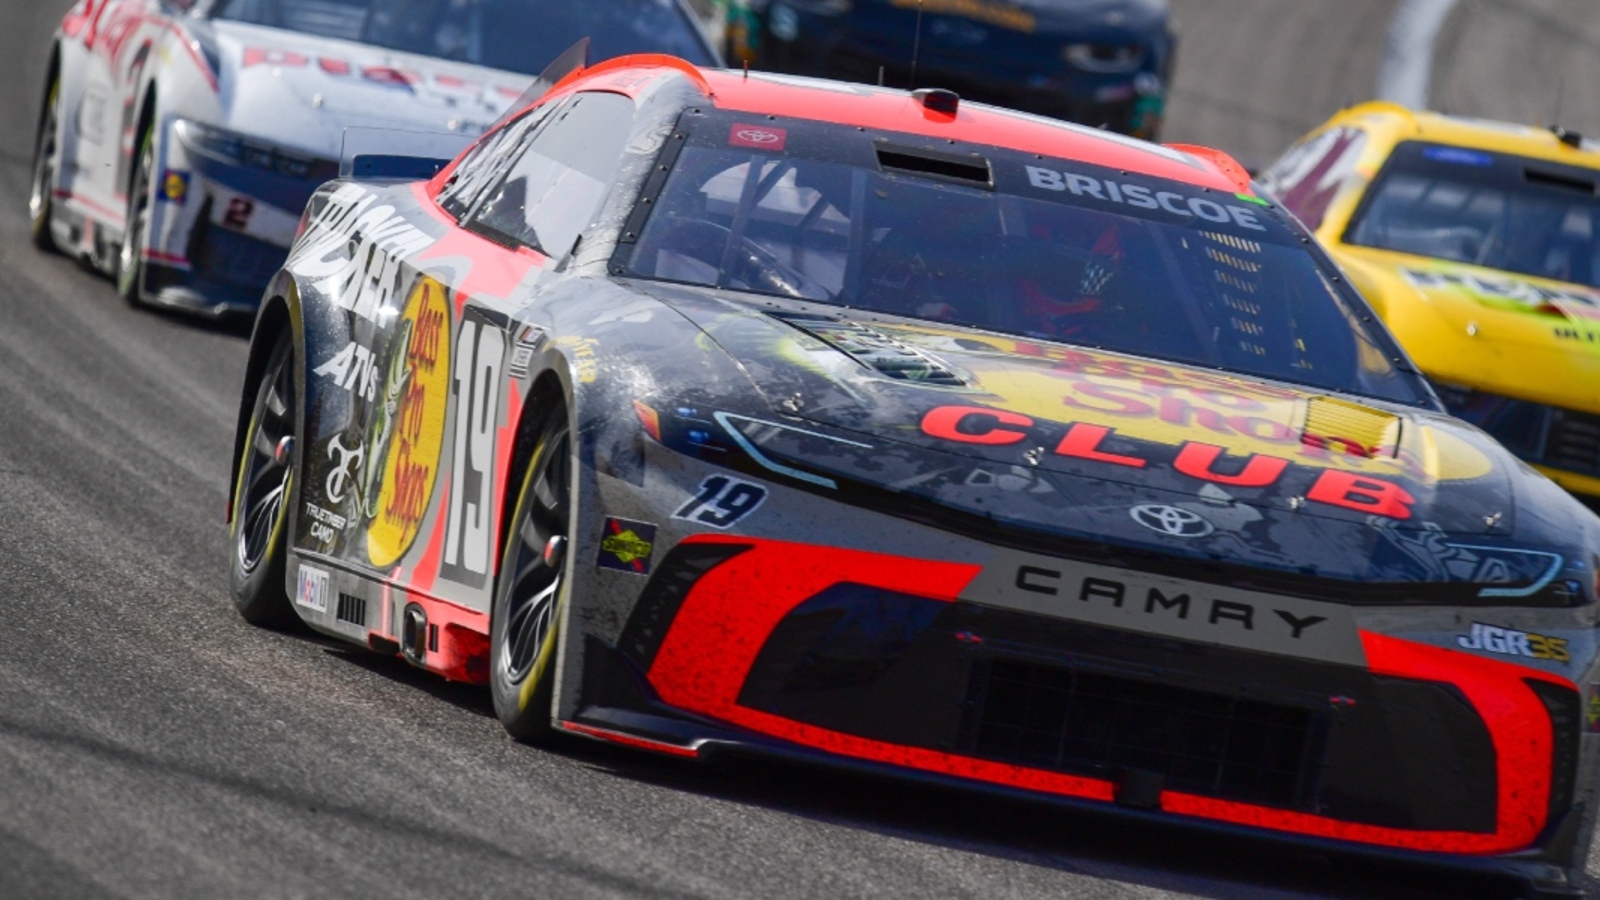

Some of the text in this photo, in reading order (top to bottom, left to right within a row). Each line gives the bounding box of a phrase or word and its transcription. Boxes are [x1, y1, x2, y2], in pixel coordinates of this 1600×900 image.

[224, 198, 254, 229] 2
[1026, 164, 1264, 230] BRISCOE
[409, 282, 443, 372] Bass
[313, 341, 380, 402] ATVs
[444, 319, 503, 573] 19
[920, 404, 1416, 519] CLUB
[310, 521, 335, 544] CAMO
[669, 473, 769, 529] 19
[1015, 564, 1328, 639] CAMRY
[1456, 622, 1571, 663] JGR35
